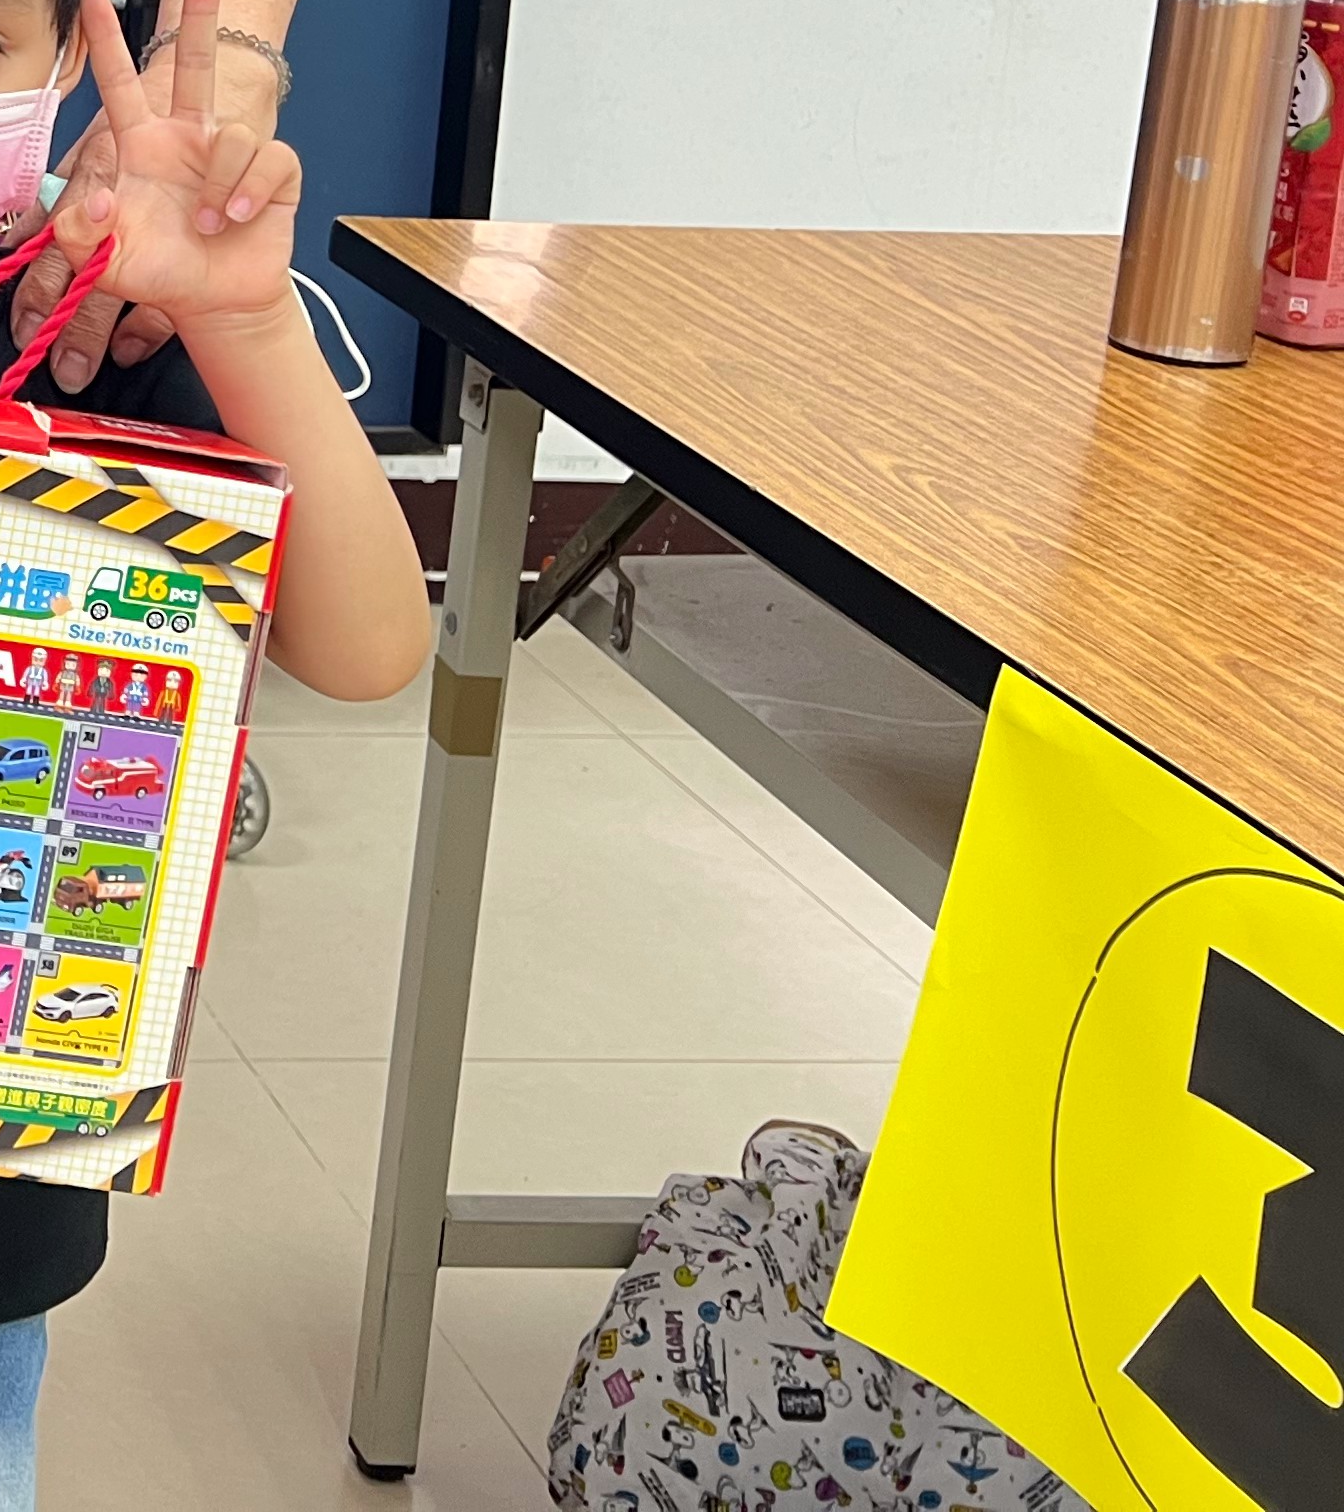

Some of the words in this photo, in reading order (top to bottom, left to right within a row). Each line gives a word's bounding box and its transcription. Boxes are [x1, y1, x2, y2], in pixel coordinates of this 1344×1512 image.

[128, 570, 170, 601] 36
[168, 587, 198, 604] pcs
[68, 624, 189, 656] Size:70x51cm
